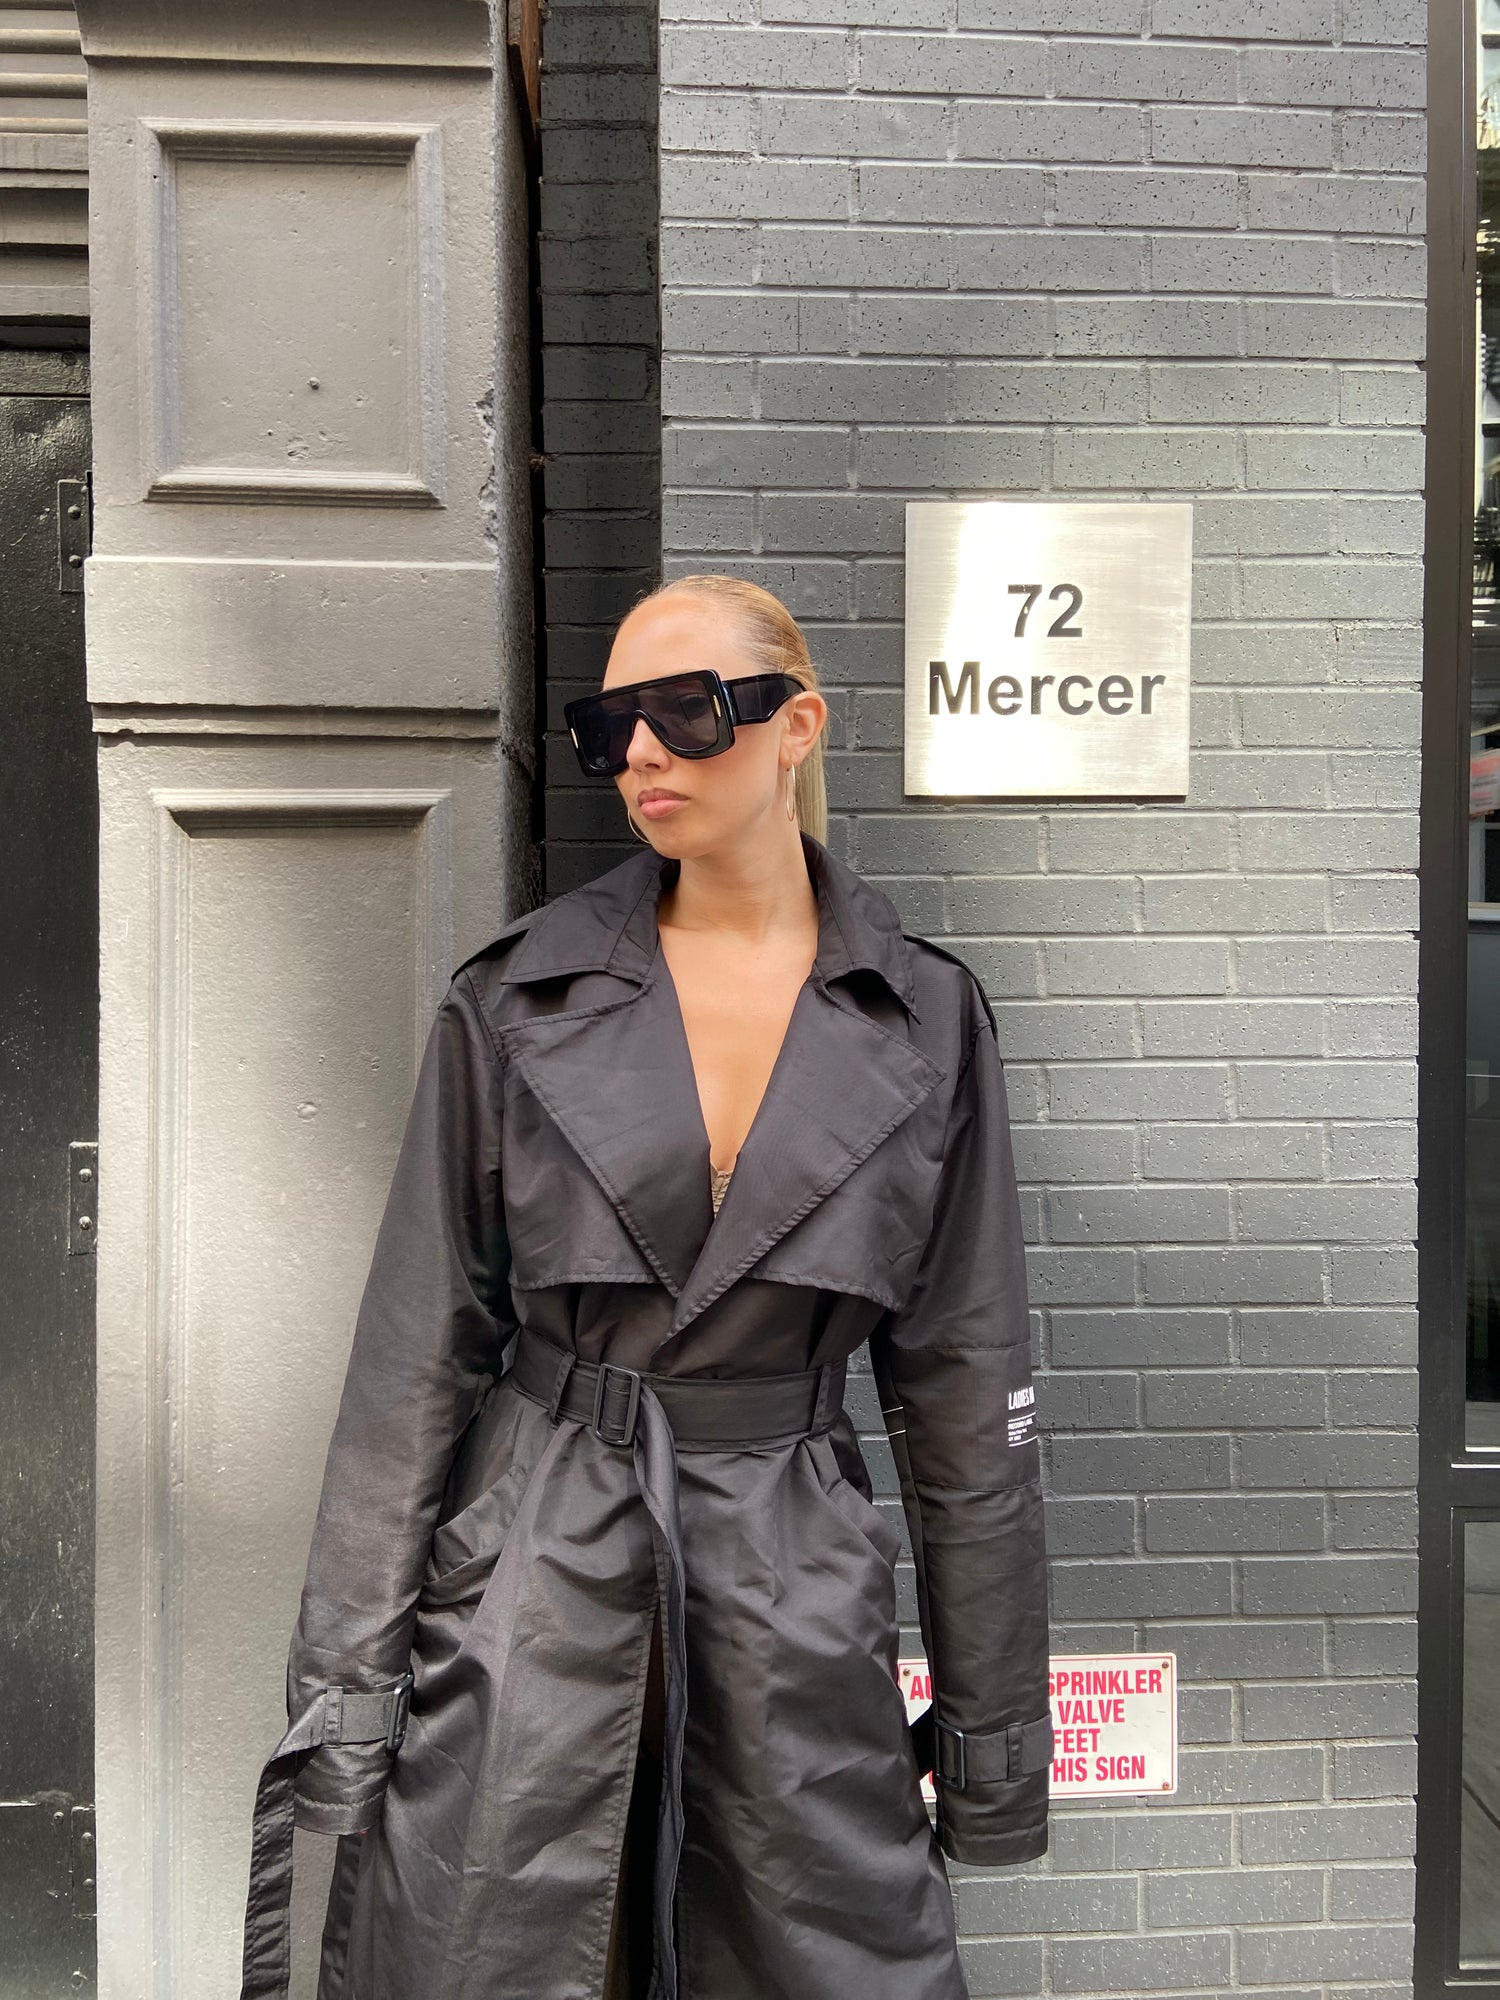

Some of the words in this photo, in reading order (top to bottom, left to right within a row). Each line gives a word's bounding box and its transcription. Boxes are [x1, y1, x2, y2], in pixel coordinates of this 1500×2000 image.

[1008, 583, 1083, 638] 72
[929, 661, 1166, 716] Mercer
[1048, 1669, 1162, 1697] SPRINKLER
[1057, 1699, 1125, 1725] VALVE
[1053, 1728, 1101, 1753] FEET
[1053, 1757, 1088, 1782] HIS
[1095, 1755, 1145, 1781] SIGN
